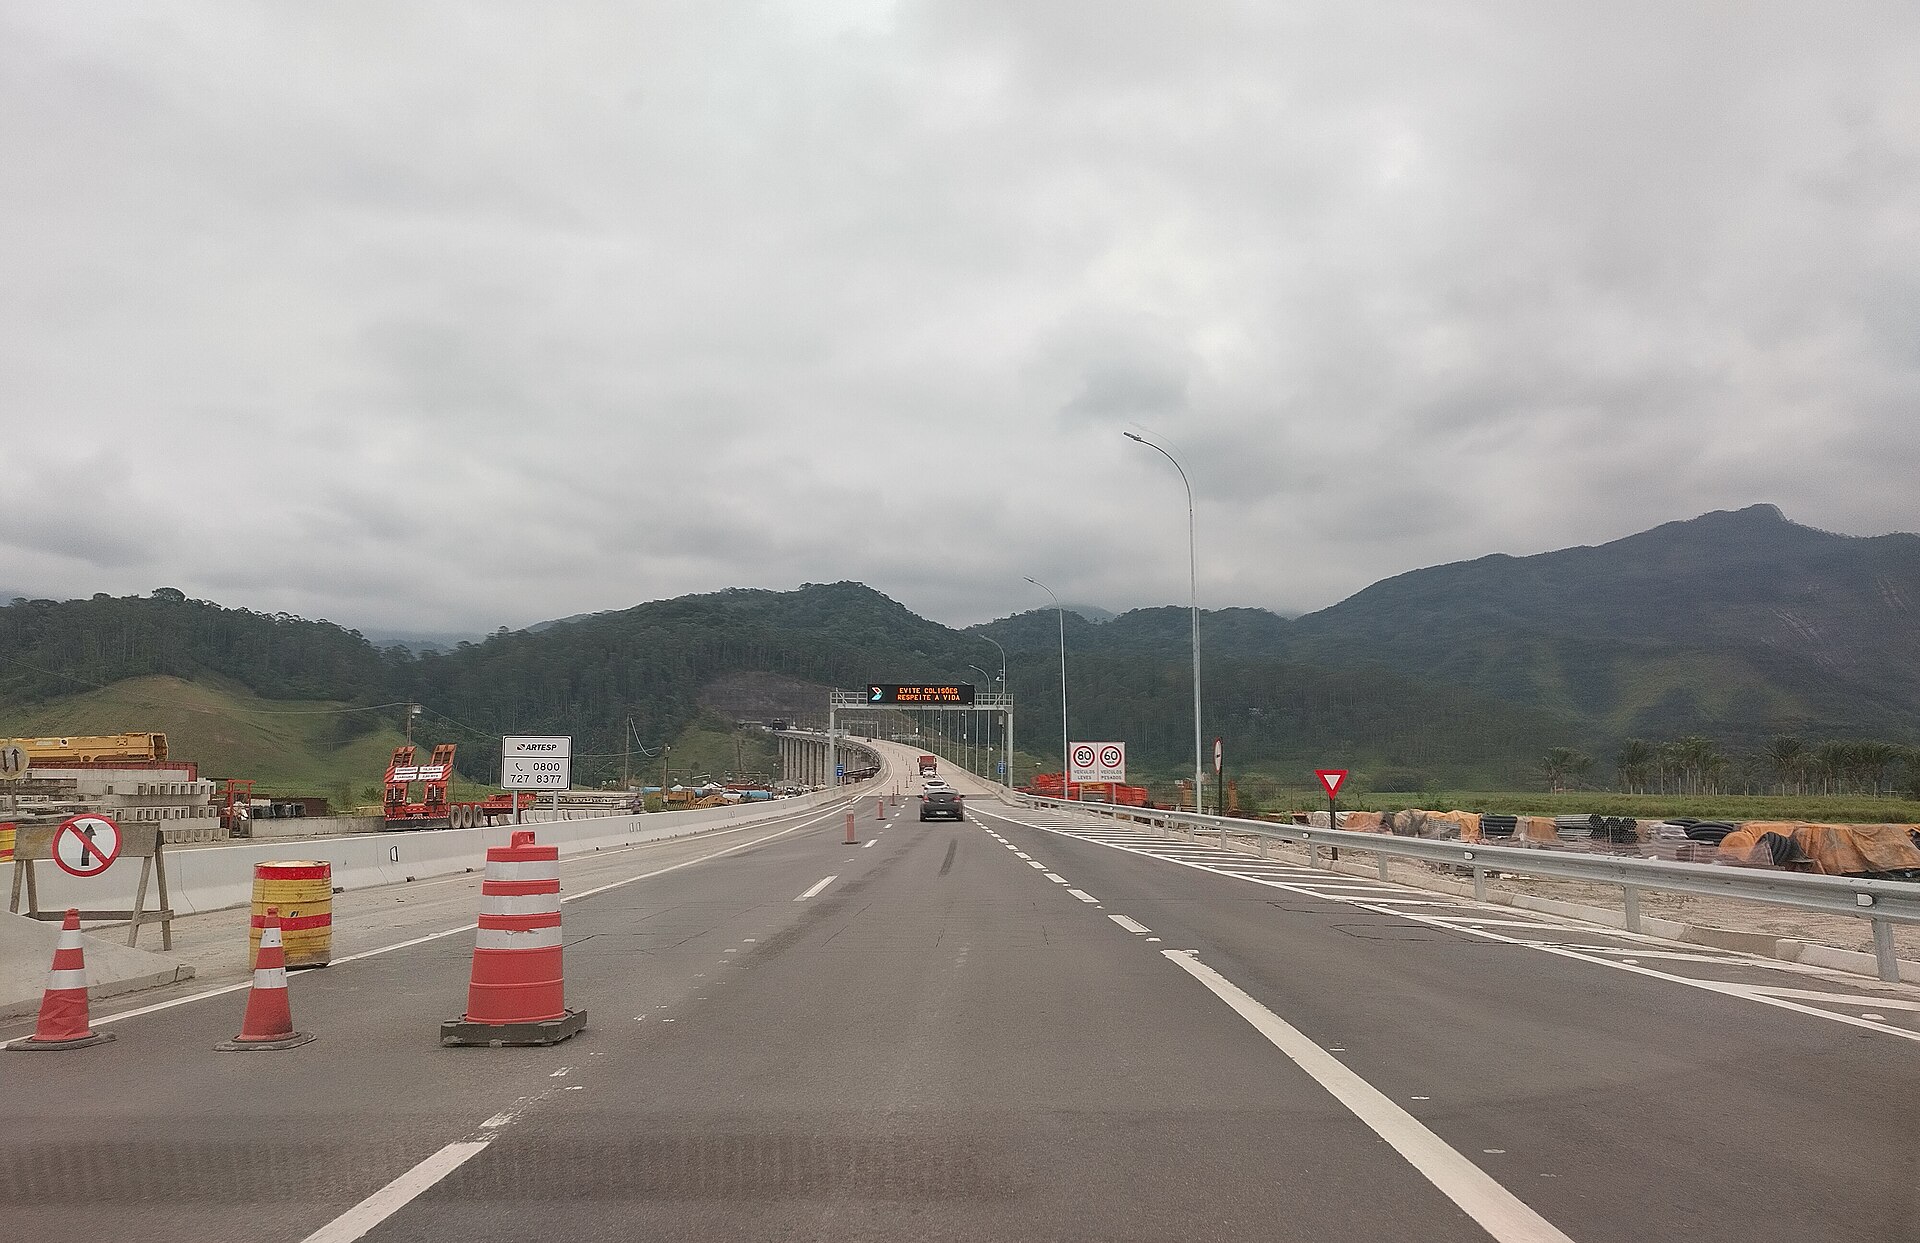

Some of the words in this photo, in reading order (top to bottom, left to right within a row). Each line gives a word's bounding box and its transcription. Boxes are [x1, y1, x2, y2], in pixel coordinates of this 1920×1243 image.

[1077, 751, 1091, 760] 80
[1104, 751, 1118, 760] 60
[533, 763, 560, 771] 0800
[510, 775, 529, 783] 727
[536, 775, 561, 783] 8377
